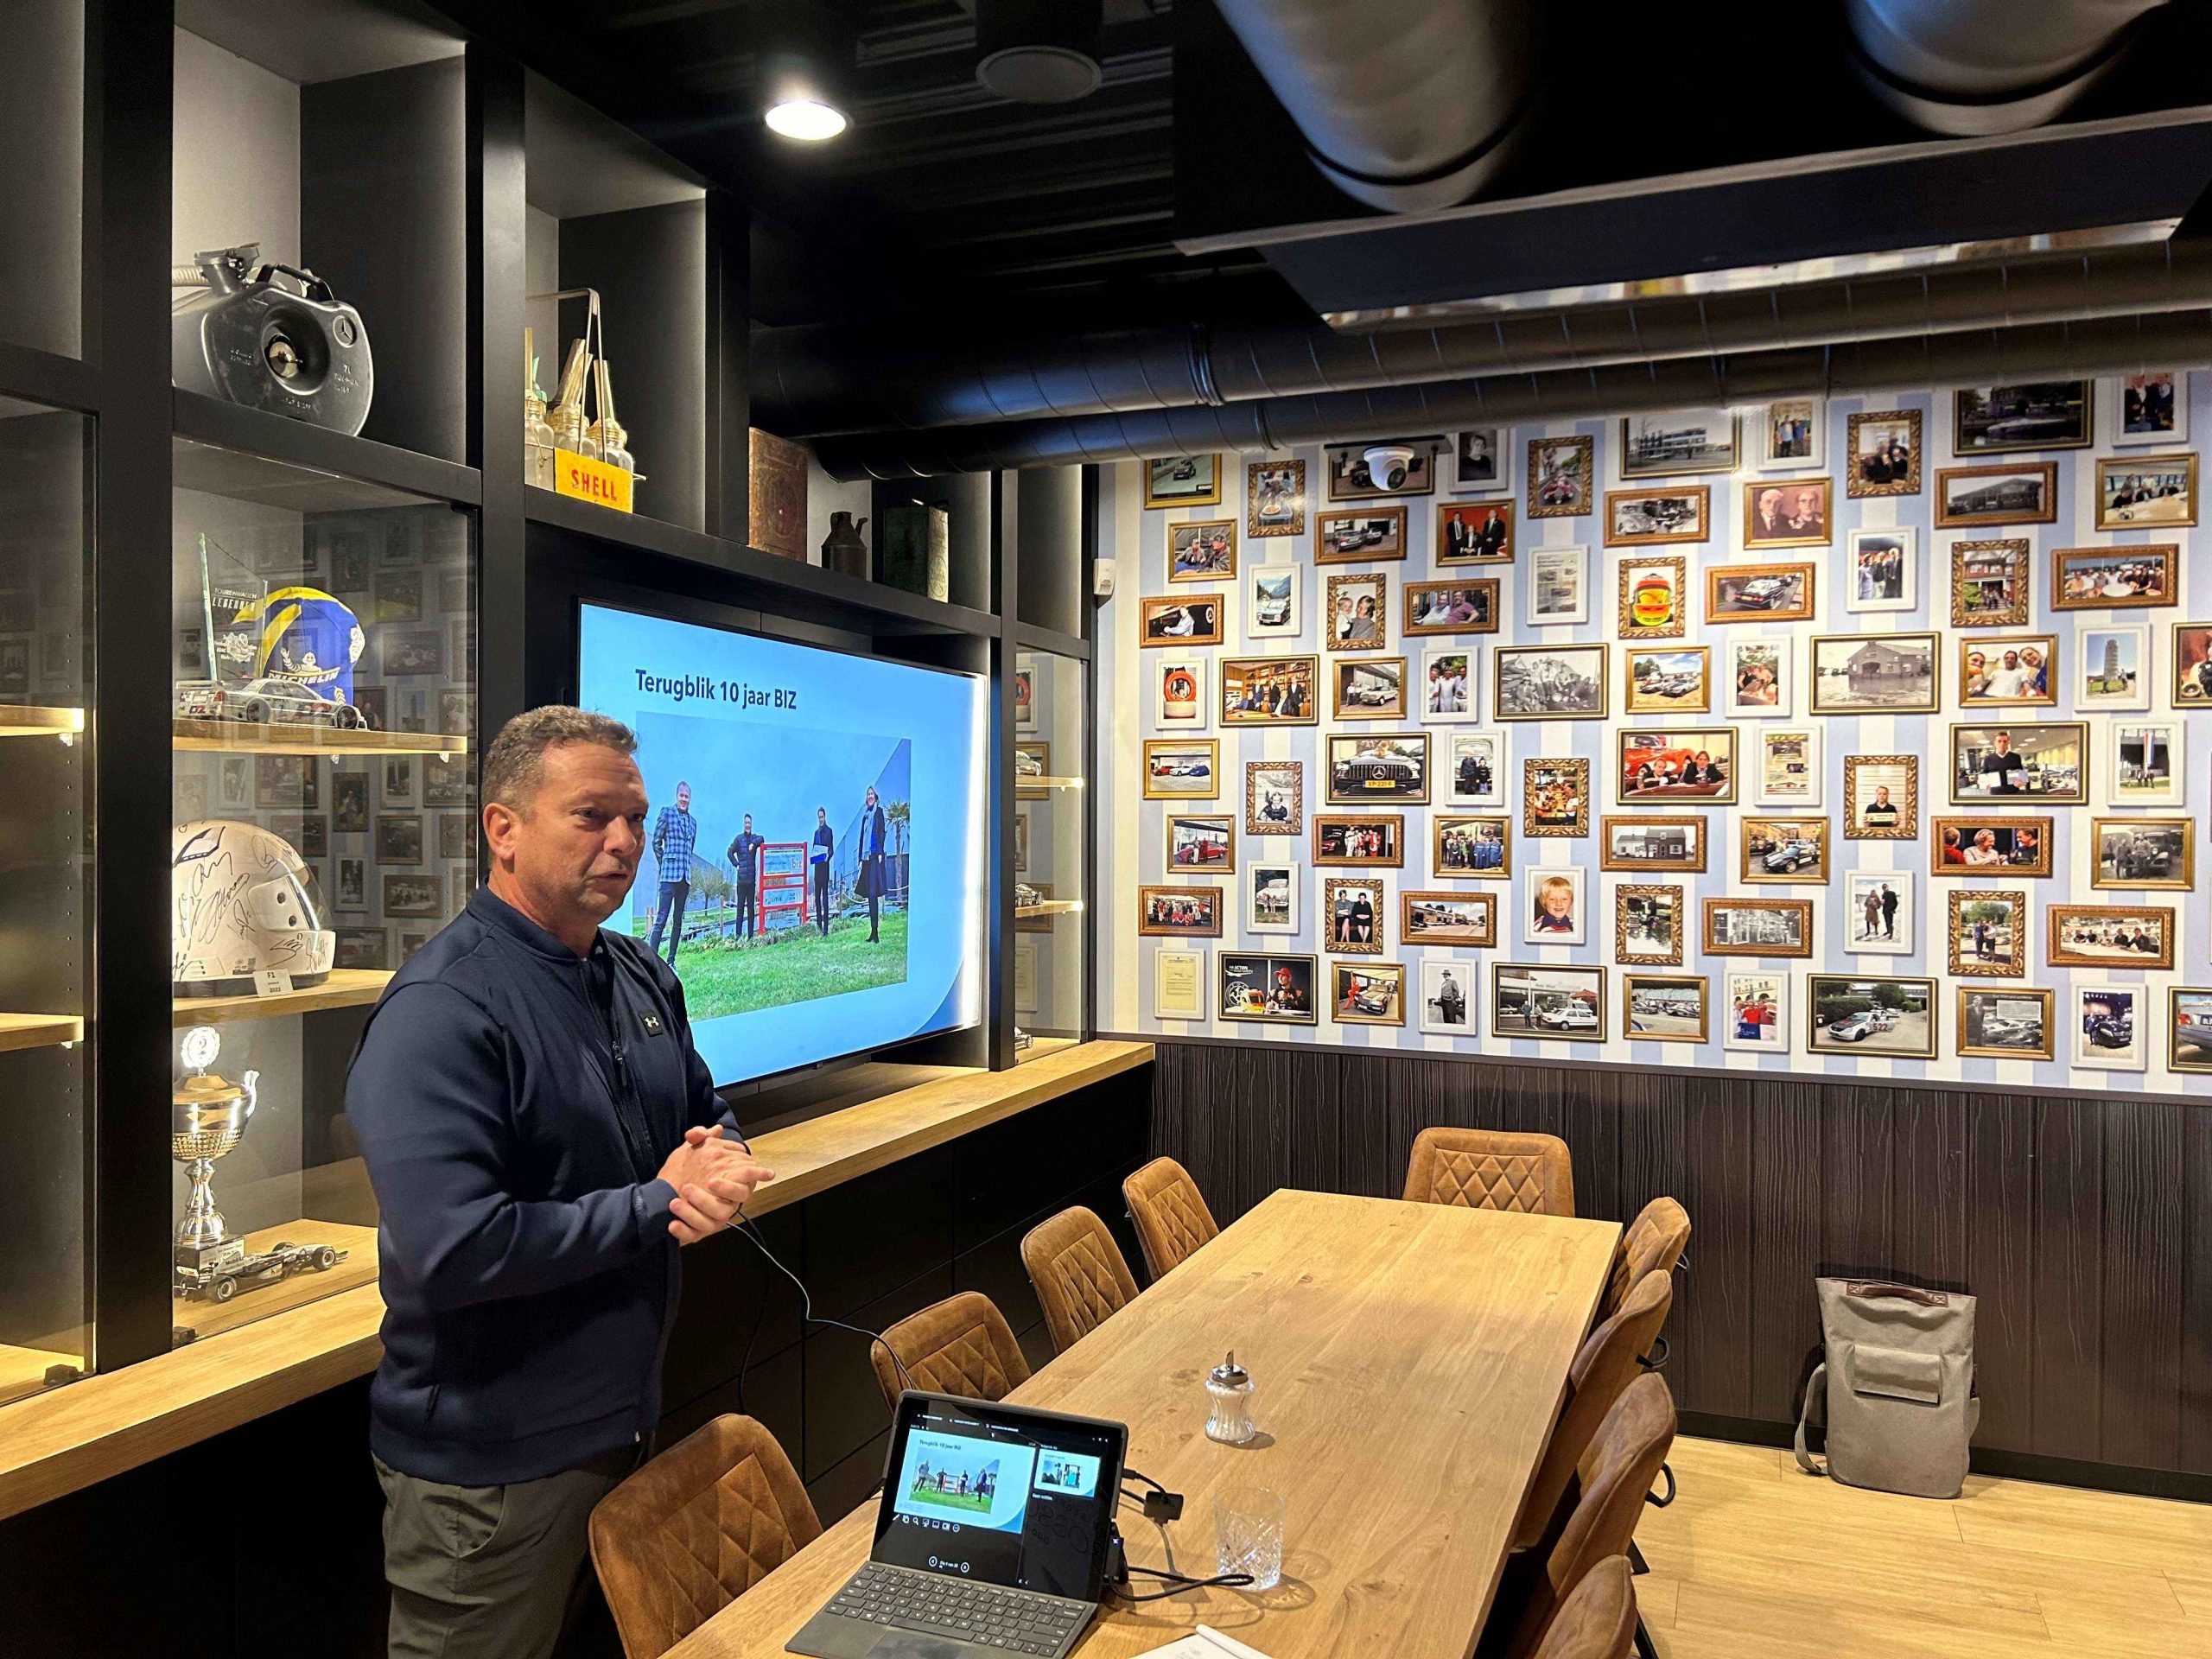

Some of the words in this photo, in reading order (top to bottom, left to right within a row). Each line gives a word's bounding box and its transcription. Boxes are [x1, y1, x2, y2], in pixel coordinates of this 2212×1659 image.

[571, 468, 617, 501] SHELL
[214, 588, 257, 599] TOURENWAGEN
[268, 671, 340, 685] MICHELIN
[635, 669, 715, 702] Terugblik
[720, 681, 739, 702] 10
[742, 683, 771, 709] jaar
[774, 689, 797, 710] BIZ
[1872, 1022, 1888, 1031] 522
